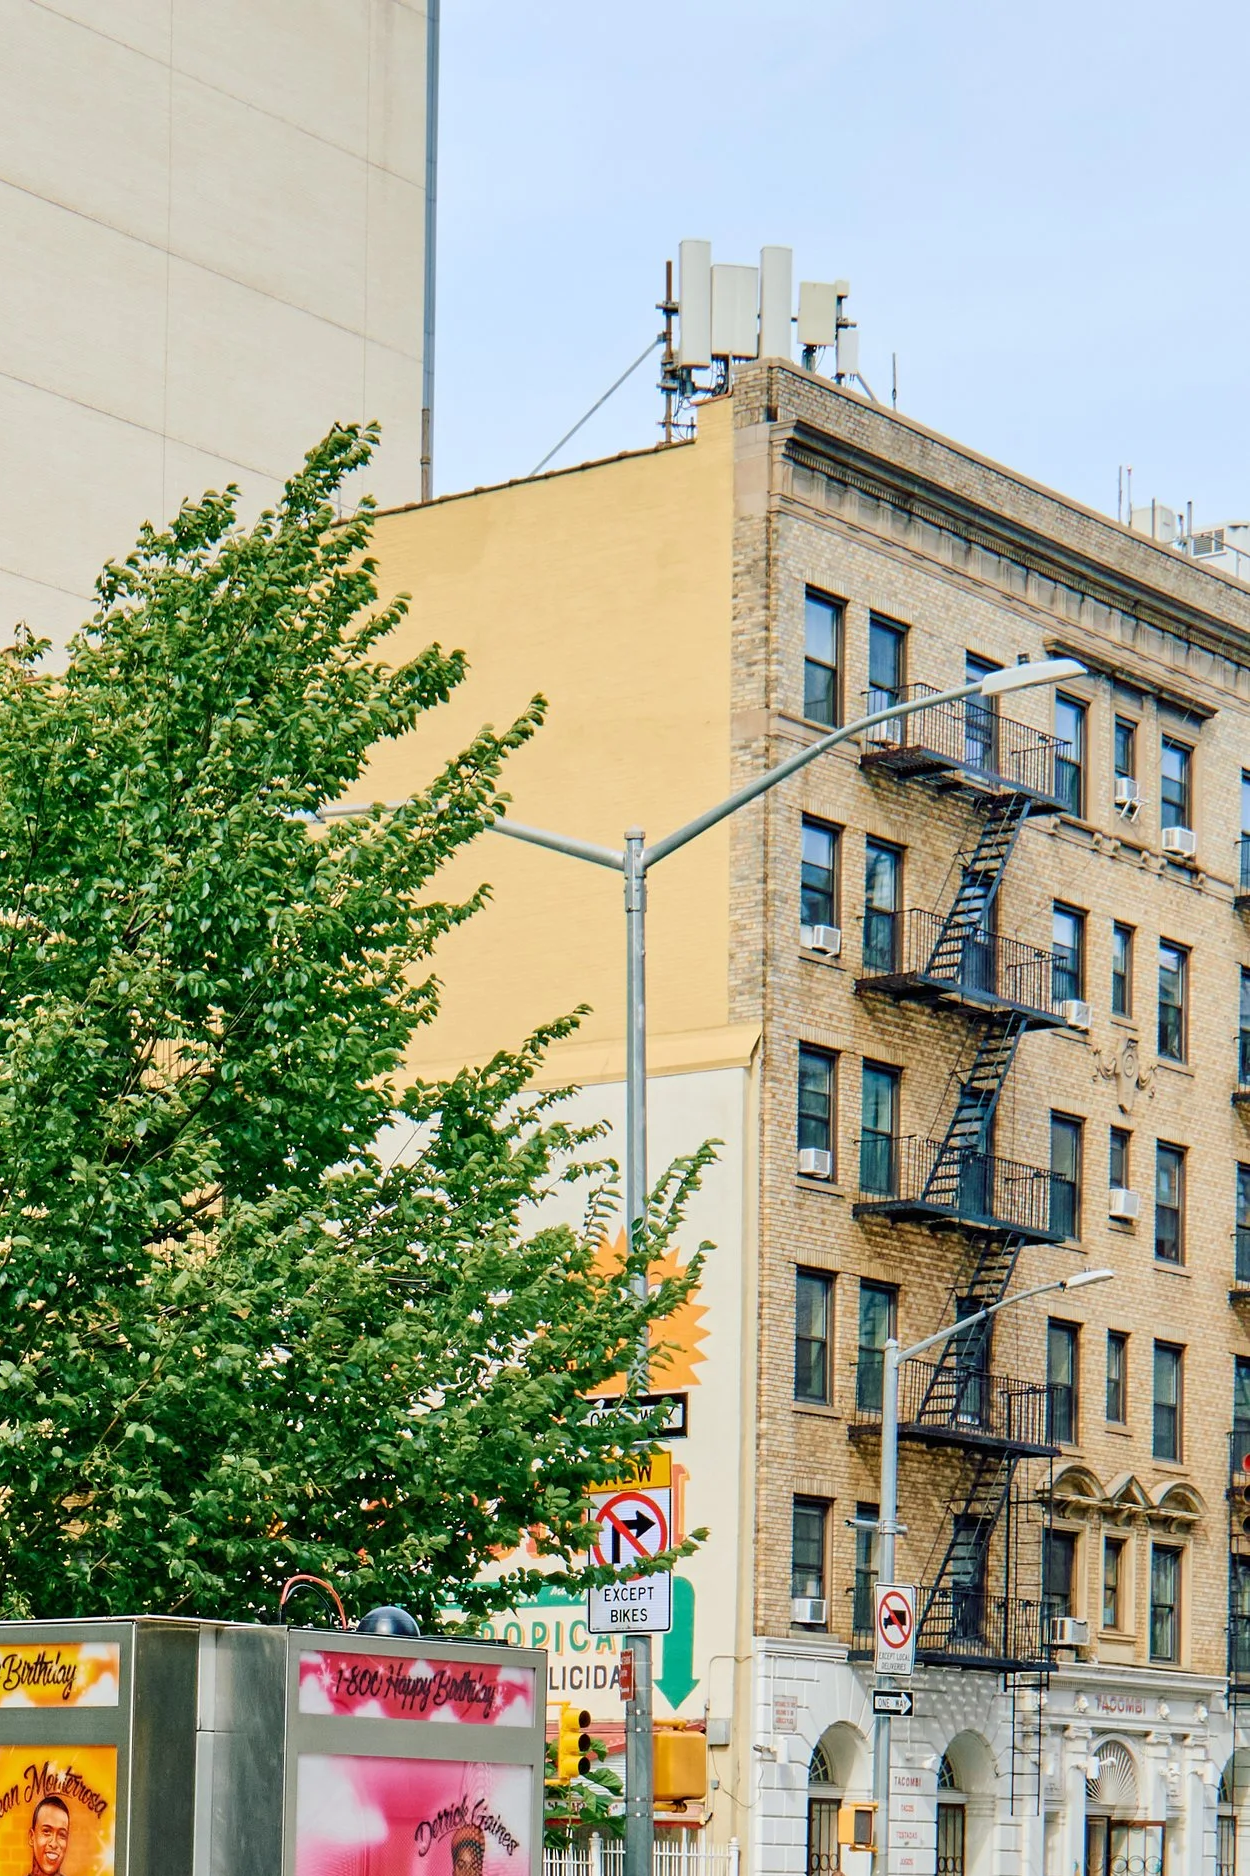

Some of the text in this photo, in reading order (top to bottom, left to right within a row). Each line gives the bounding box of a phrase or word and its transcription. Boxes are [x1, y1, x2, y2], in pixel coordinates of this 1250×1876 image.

[604, 1587, 654, 1602] EXCEPT
[610, 1608, 648, 1623] BIKES
[878, 1652, 896, 1660] EXCEPT
[3, 1651, 77, 1700] Birthday
[336, 1665, 383, 1697] 1-800
[384, 1661, 431, 1712] Happy
[878, 1698, 907, 1708] ONE WAY
[894, 1776, 922, 1788] TACOMBI
[471, 1798, 519, 1856] Gaines
